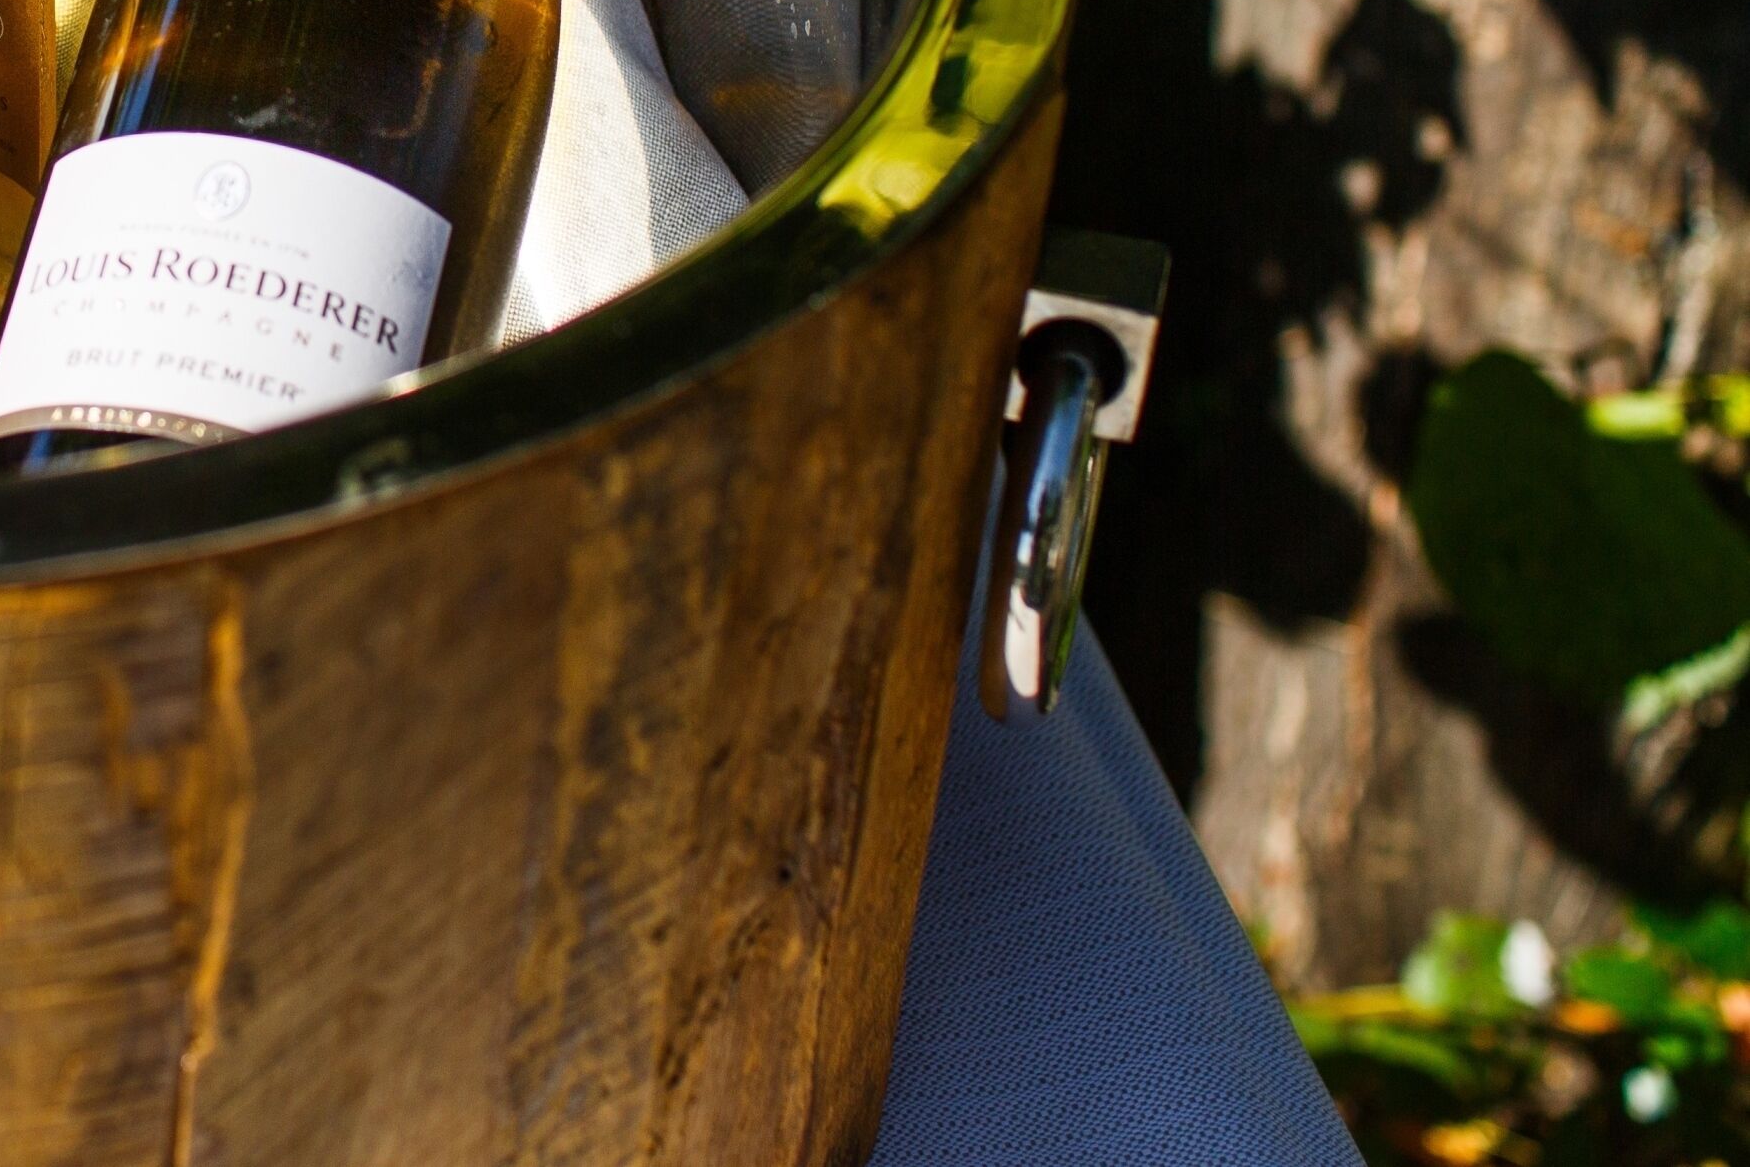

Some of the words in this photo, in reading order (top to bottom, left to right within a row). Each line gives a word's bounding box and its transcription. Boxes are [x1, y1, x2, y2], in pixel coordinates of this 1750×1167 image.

[29, 248, 137, 296] LOUIS
[151, 247, 401, 355] ROEDERER
[65, 346, 147, 368] BRUT
[155, 351, 300, 402] PREMIER
